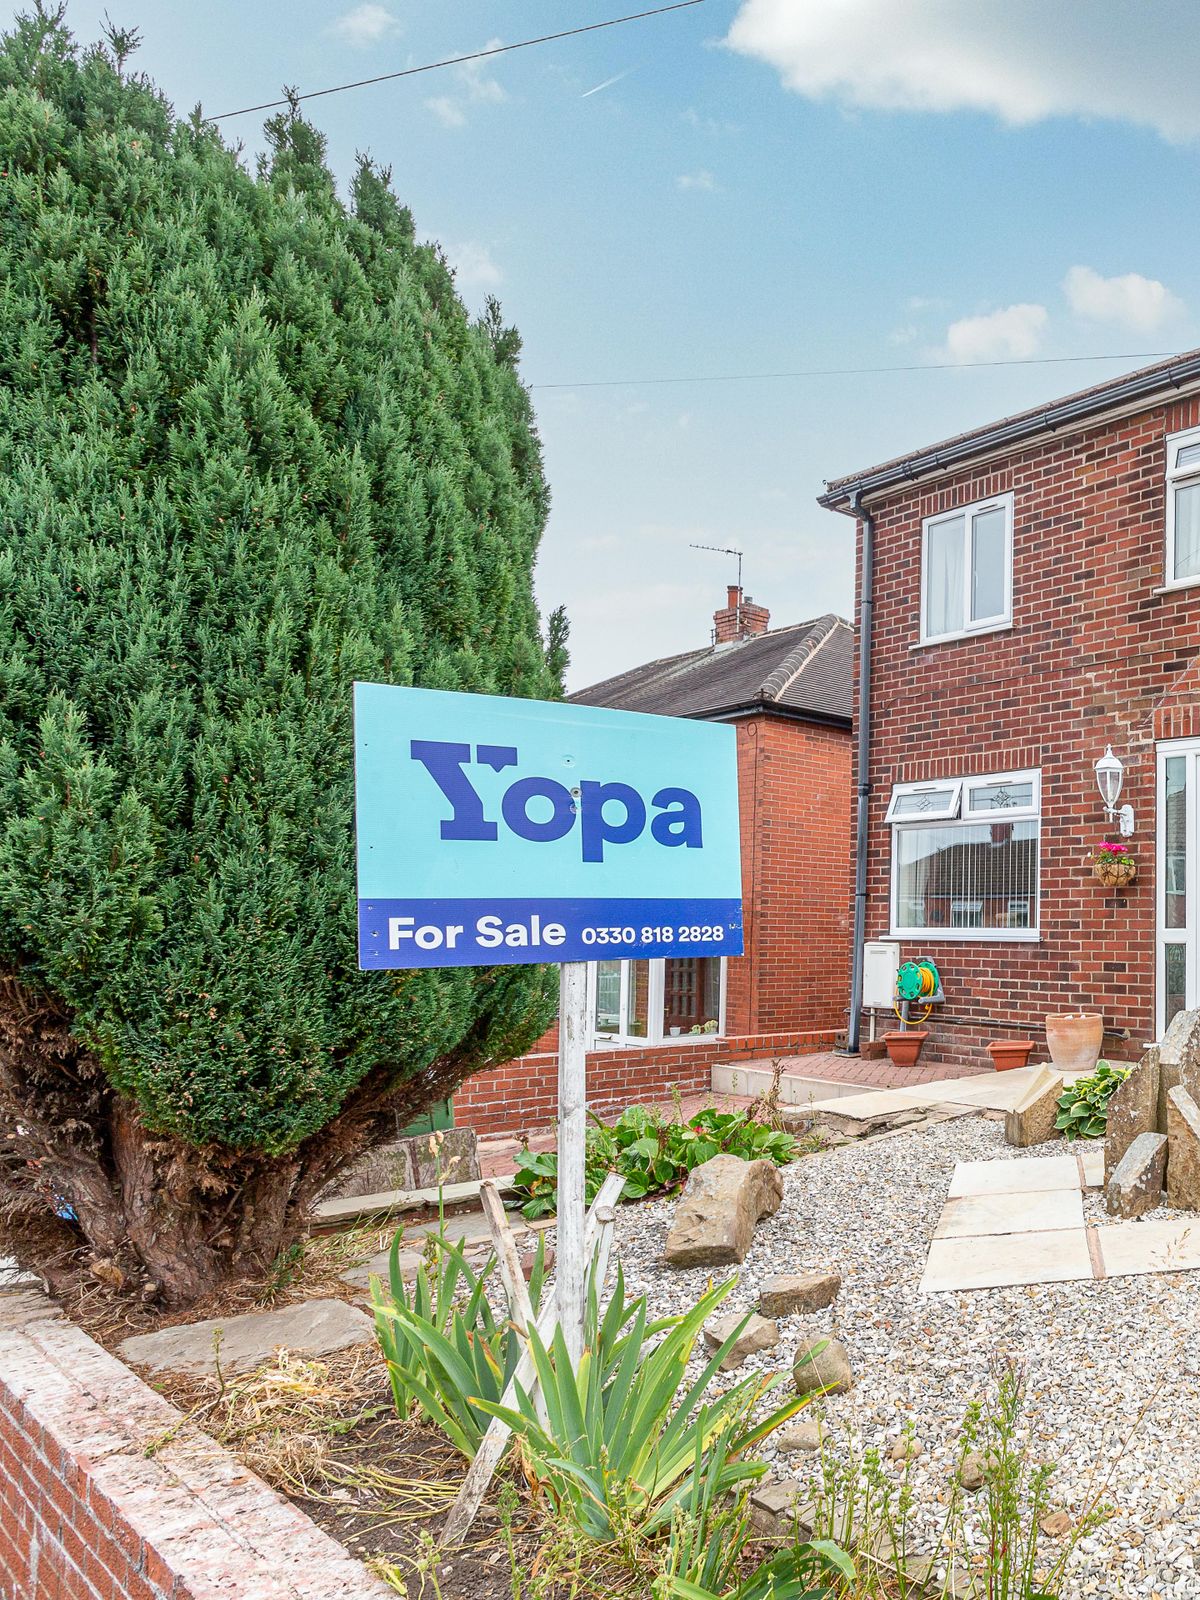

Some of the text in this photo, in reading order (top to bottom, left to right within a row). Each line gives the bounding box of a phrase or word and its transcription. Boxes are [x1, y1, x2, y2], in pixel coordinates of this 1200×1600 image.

[410, 739, 703, 863] Yopa
[388, 914, 724, 951] For Sale 0330 818 2828
